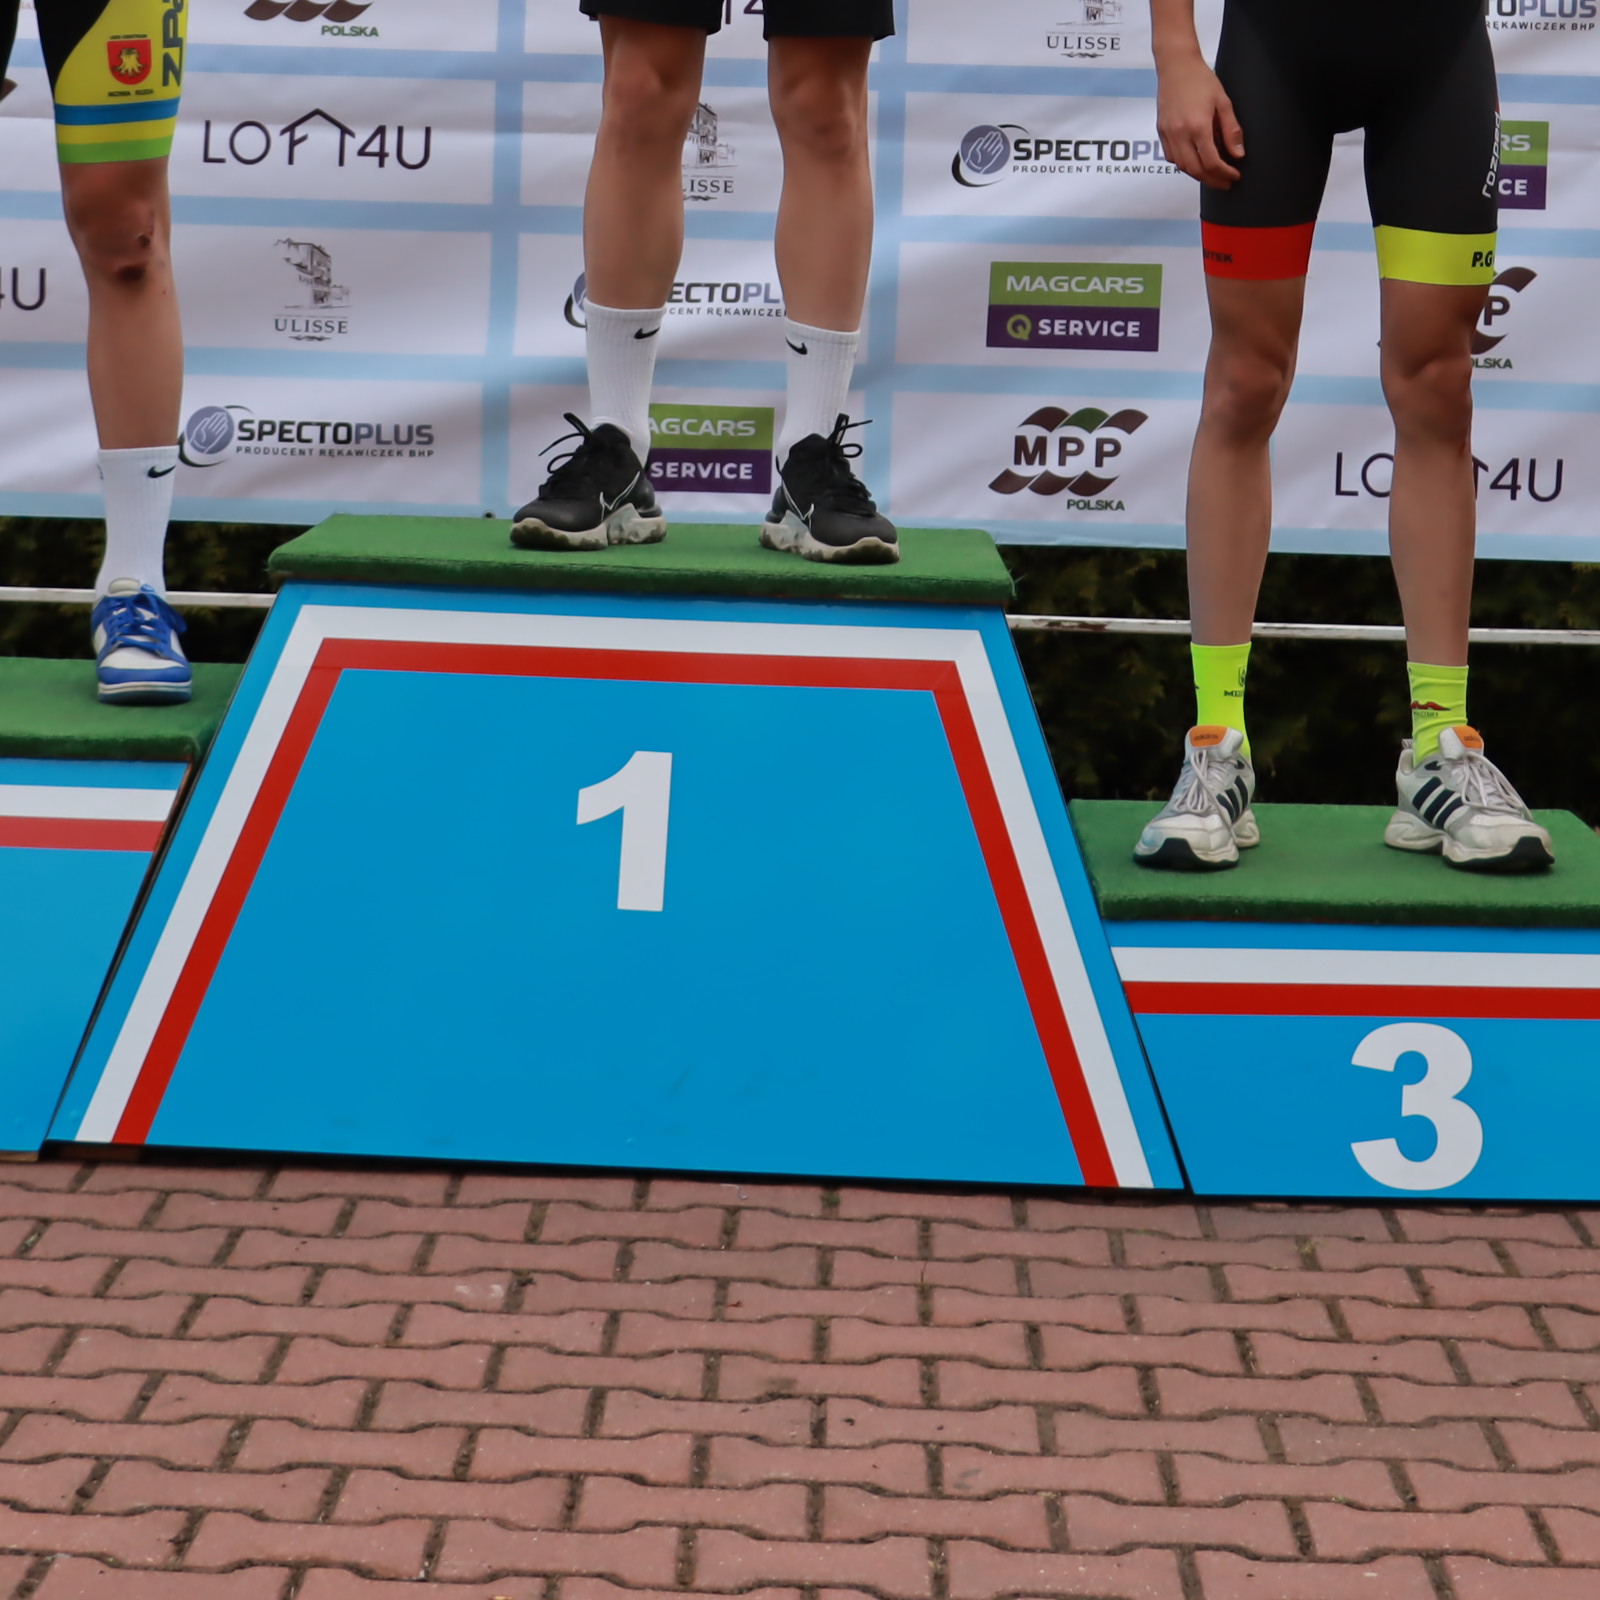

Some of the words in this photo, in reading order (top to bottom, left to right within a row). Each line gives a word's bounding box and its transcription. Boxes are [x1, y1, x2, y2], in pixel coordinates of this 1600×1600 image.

[321, 25, 379, 38] POLSKA
[1571, 22, 1596, 31] BHP
[1045, 35, 1121, 51] ULISSE
[202, 107, 432, 170] LOFT4U
[1012, 139, 1167, 162] SPECTOPL
[1012, 165, 1092, 174] PRODUCENT
[683, 178, 734, 194] ISSE
[667, 282, 781, 304] ECTOPL
[1005, 274, 1144, 296] MAGCARS
[273, 317, 349, 335] ULISSE
[1037, 317, 1141, 338] SERVICE
[236, 417, 435, 446] SPECTOPLUS
[649, 416, 756, 437] AGCARS
[235, 446, 315, 456] PRODUCENT
[319, 447, 405, 460] RĘKAWICZEK
[408, 448, 435, 458] BHP
[1012, 434, 1122, 468] MPP
[650, 461, 753, 480] SERVICE
[1066, 498, 1125, 511] POLSKA
[574, 749, 672, 914] 1
[1346, 1022, 1486, 1193] 3
